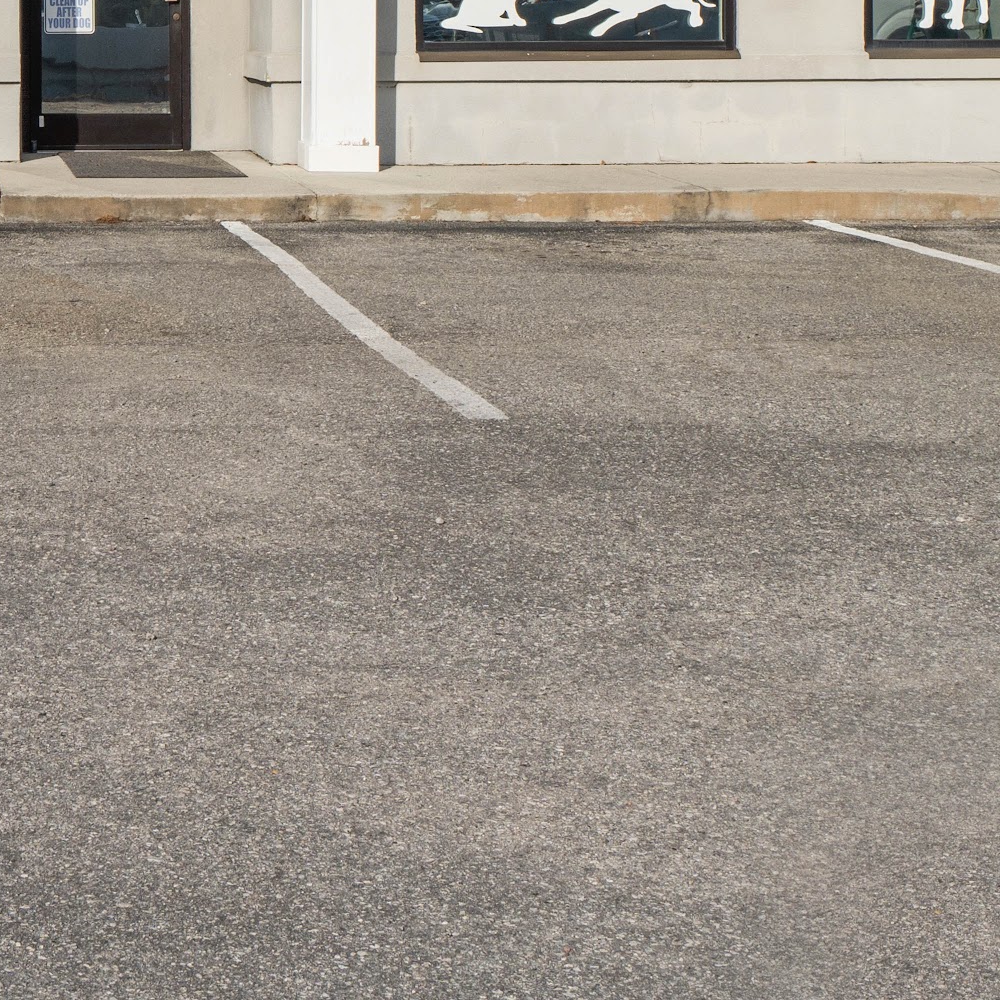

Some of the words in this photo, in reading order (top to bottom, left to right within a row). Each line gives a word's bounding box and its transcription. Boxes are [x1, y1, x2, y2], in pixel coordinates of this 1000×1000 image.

[57, 7, 82, 17] AFTER
[48, 18, 70, 28] YOUR
[73, 18, 91, 28] DOG
